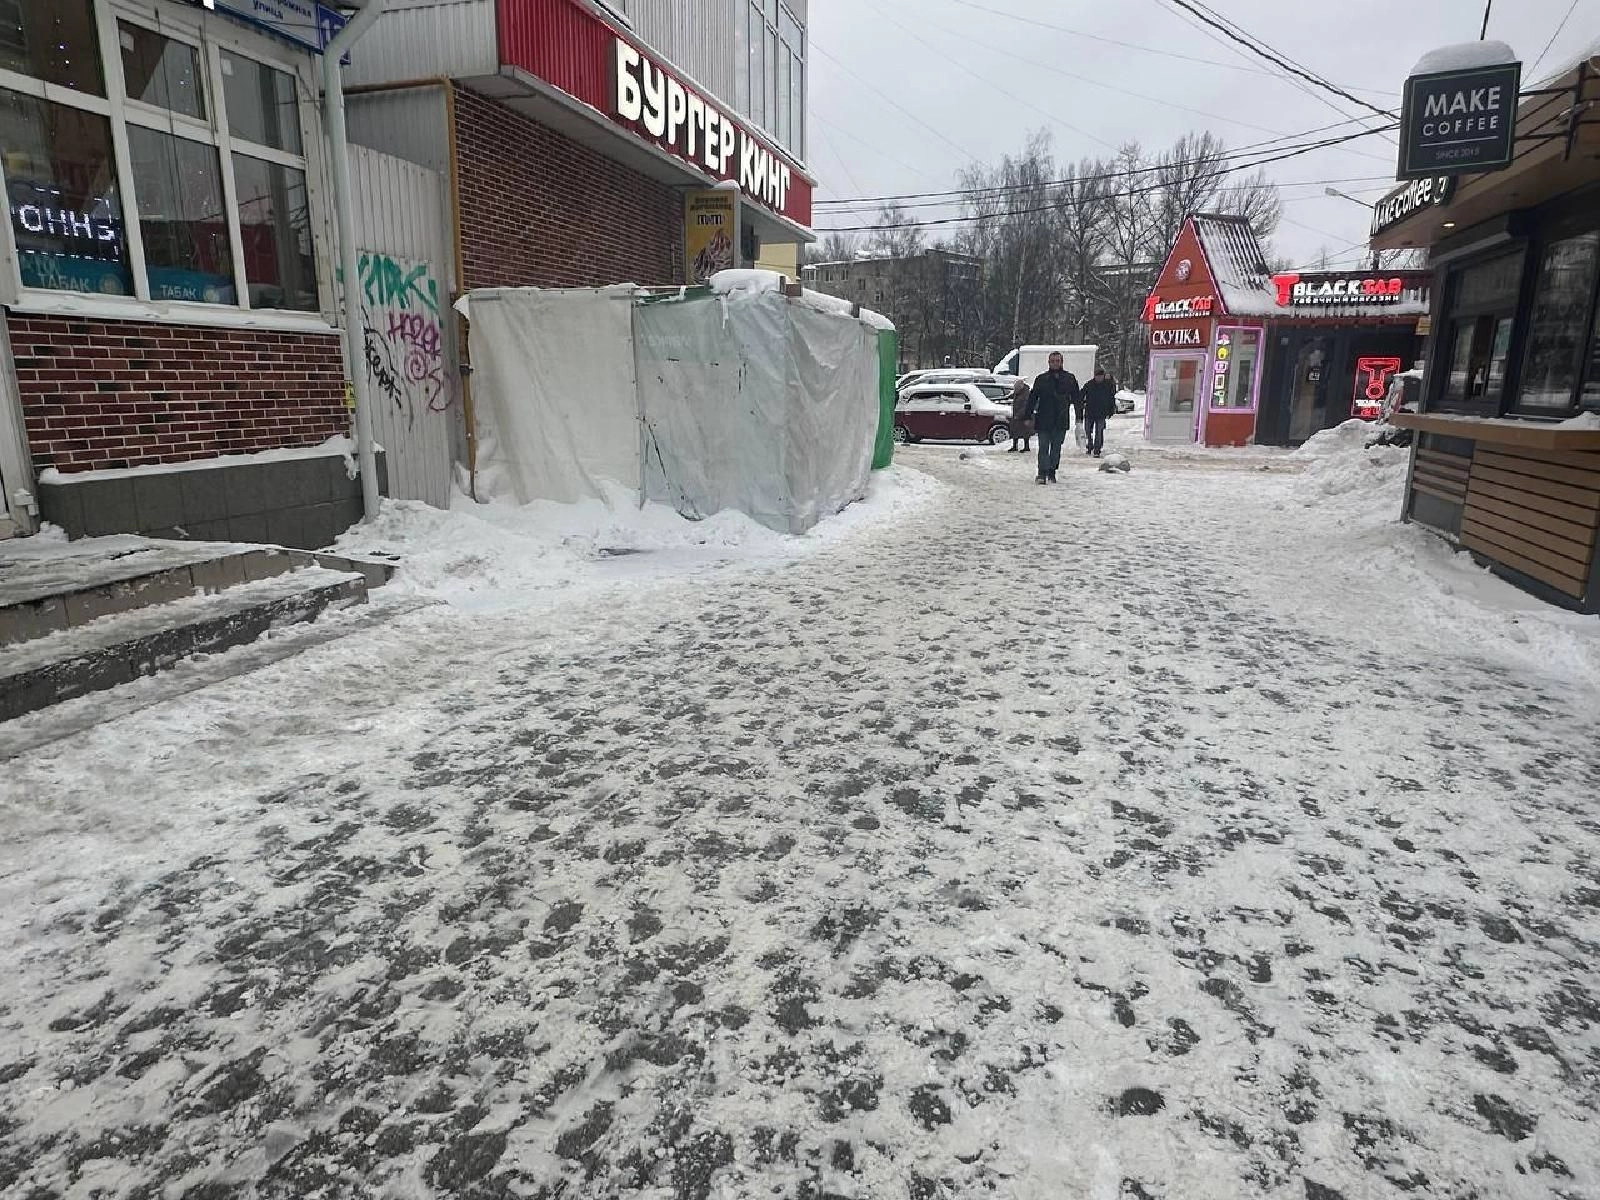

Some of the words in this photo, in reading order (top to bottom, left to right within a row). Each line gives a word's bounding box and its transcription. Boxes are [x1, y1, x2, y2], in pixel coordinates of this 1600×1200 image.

[253, 0, 284, 20] улица
[1424, 86, 1500, 118] MAKE
[616, 37, 735, 175] БУРГЕР
[740, 129, 790, 211] КИНГ
[1422, 115, 1499, 136] COFFEE
[39, 272, 90, 292] ТАБАК
[160, 284, 196, 299] ТАБАК
[1152, 329, 1200, 345] СКУПКА
